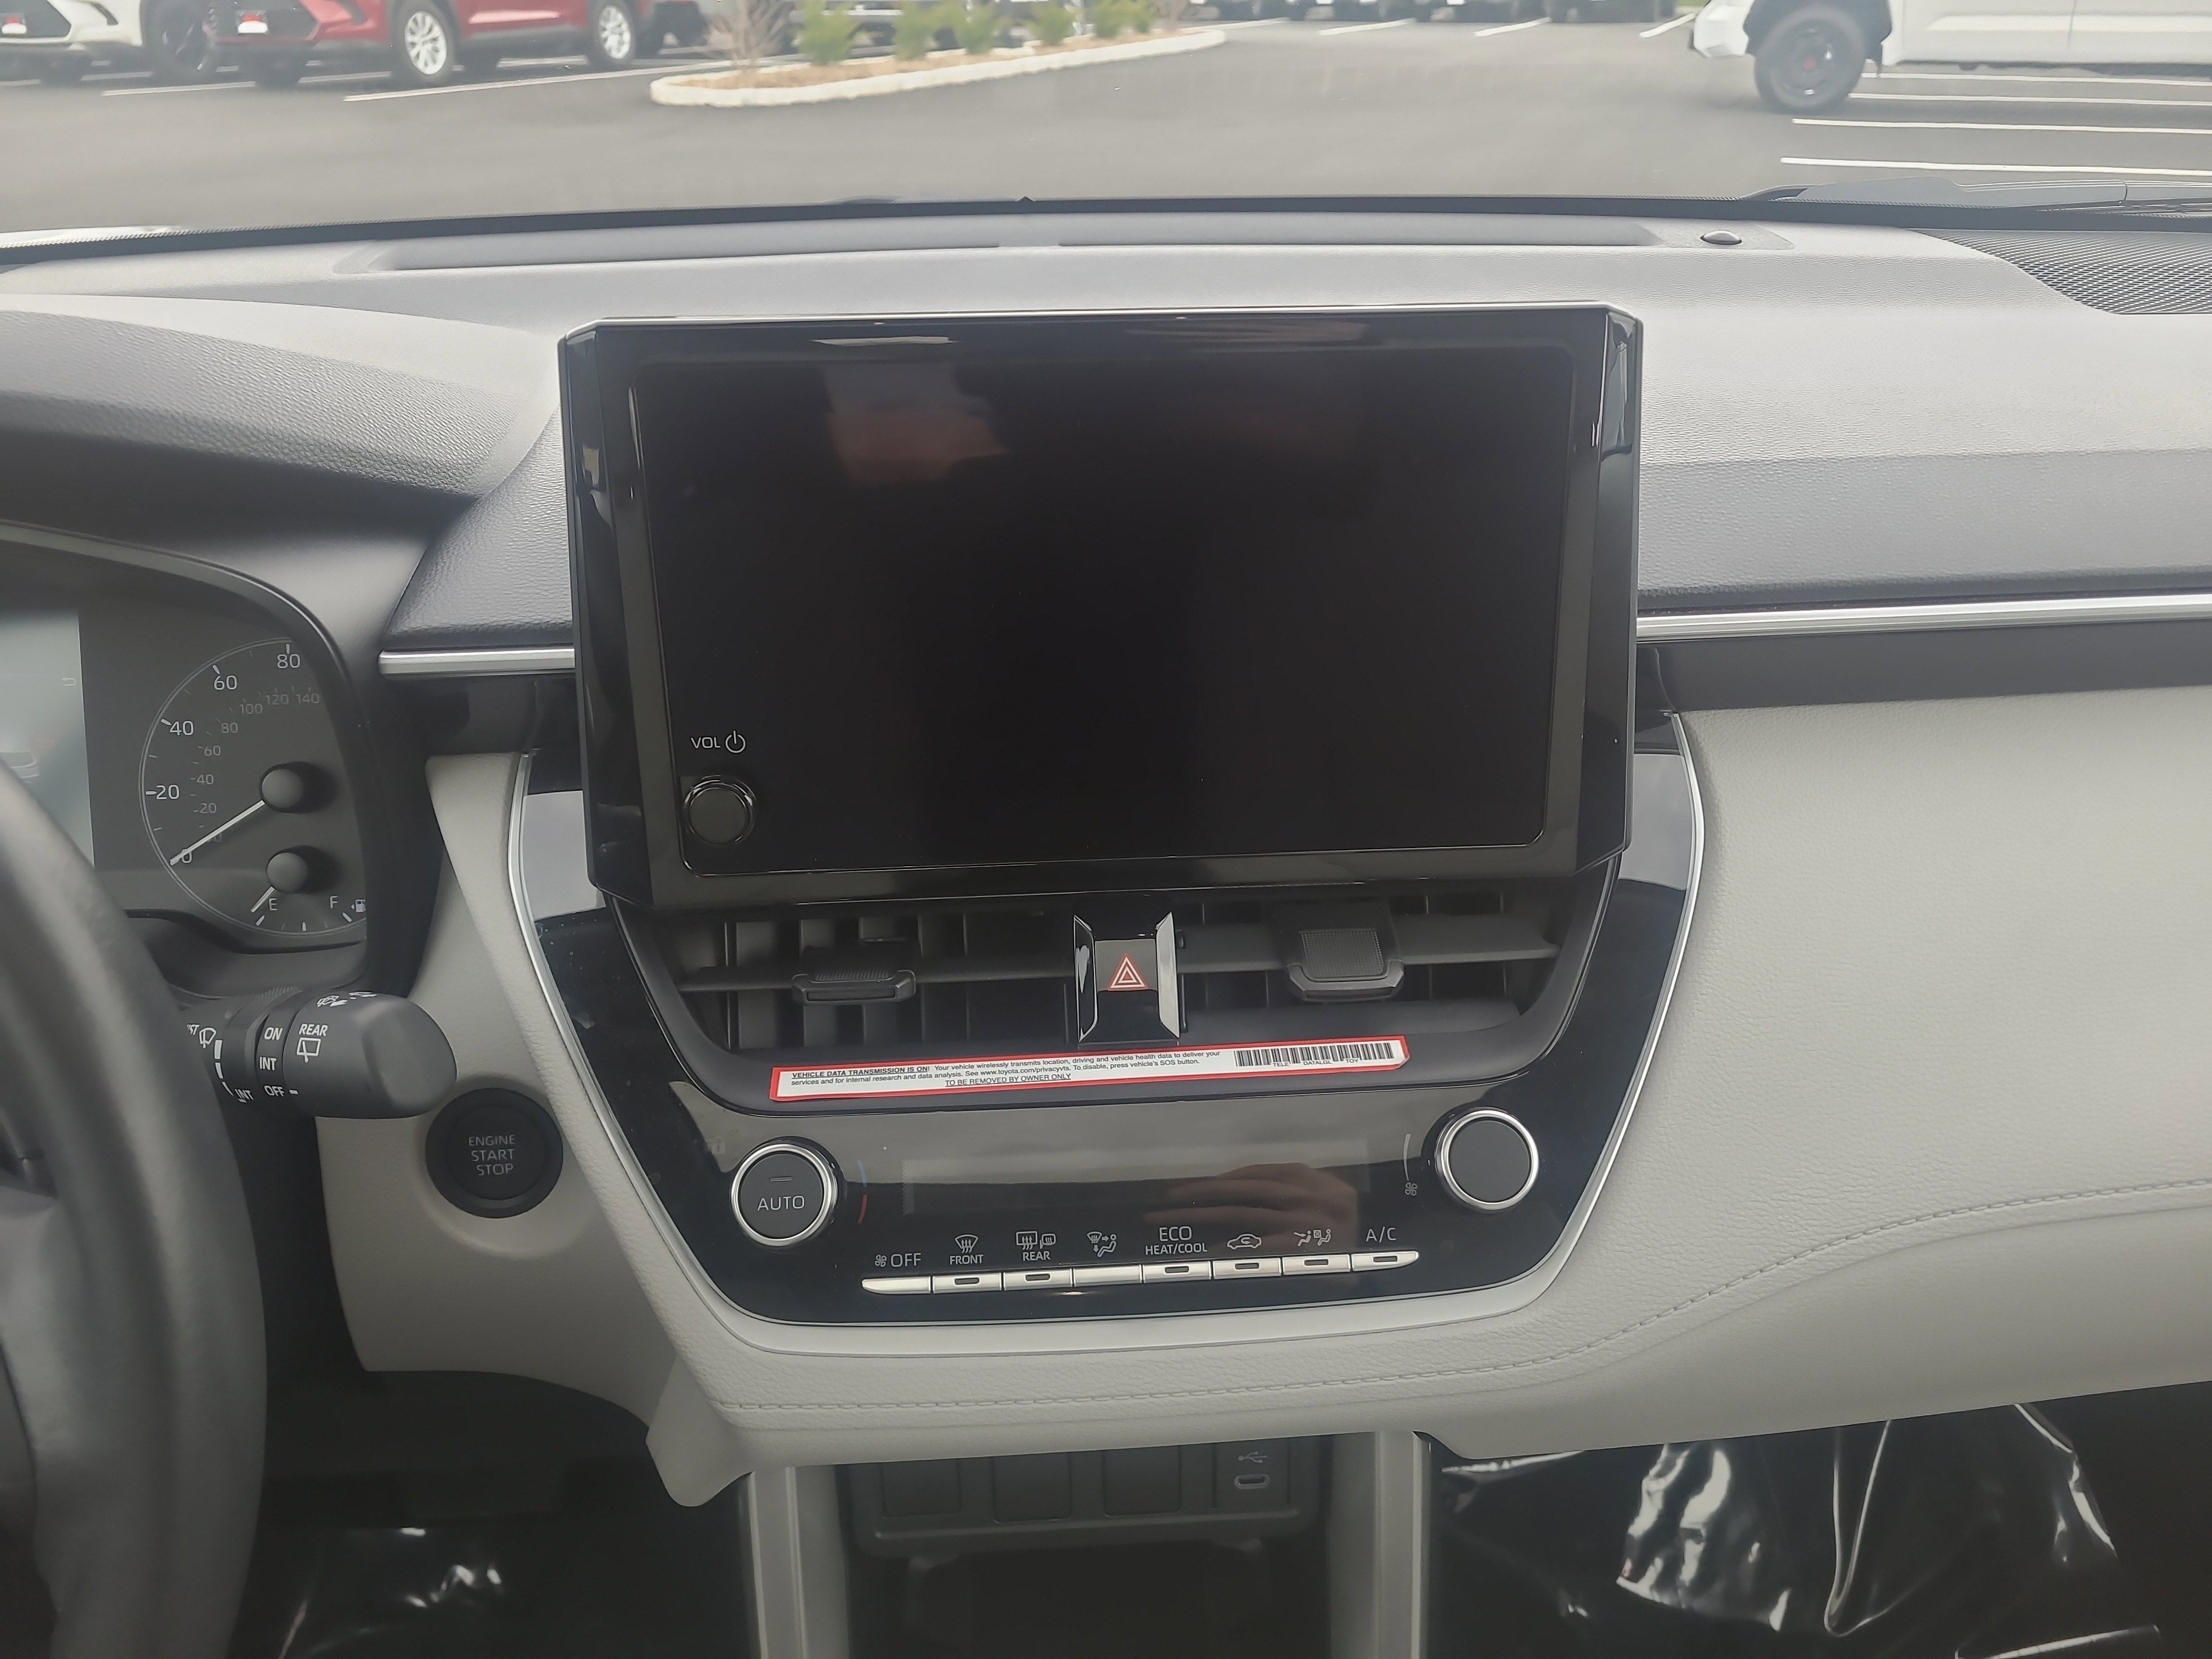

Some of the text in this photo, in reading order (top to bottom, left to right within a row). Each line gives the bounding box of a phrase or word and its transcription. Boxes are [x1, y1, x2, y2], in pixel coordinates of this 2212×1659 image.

[276, 653, 301, 669] 80
[213, 675, 238, 690] 60
[265, 694, 289, 705] 120
[296, 693, 320, 704] 140
[239, 704, 263, 714] 100
[170, 721, 194, 736] 40
[221, 723, 238, 733] 80
[690, 737, 721, 748] VOL
[204, 746, 221, 756] 60
[196, 774, 214, 785] 40
[155, 785, 180, 800] 20
[199, 803, 217, 814] 20
[180, 849, 193, 864] 0
[269, 899, 277, 910] E
[330, 896, 337, 908] F
[264, 1027, 282, 1040] ON
[300, 1023, 328, 1036] REAR
[259, 1057, 277, 1070] INT
[848, 1067, 905, 1075] TRANSMISSION
[264, 1085, 285, 1097] OFF
[469, 1134, 516, 1147] ENGINE
[471, 1149, 515, 1161] START
[476, 1163, 514, 1176] STOP
[757, 1195, 805, 1211] AUTO
[1159, 1226, 1192, 1242] ECO
[1365, 1227, 1396, 1242] A/C
[1145, 1243, 1207, 1255] HEAT/COOL
[890, 1253, 922, 1267] OFF
[949, 1254, 984, 1265] FRONT
[1023, 1250, 1051, 1261] REAR
